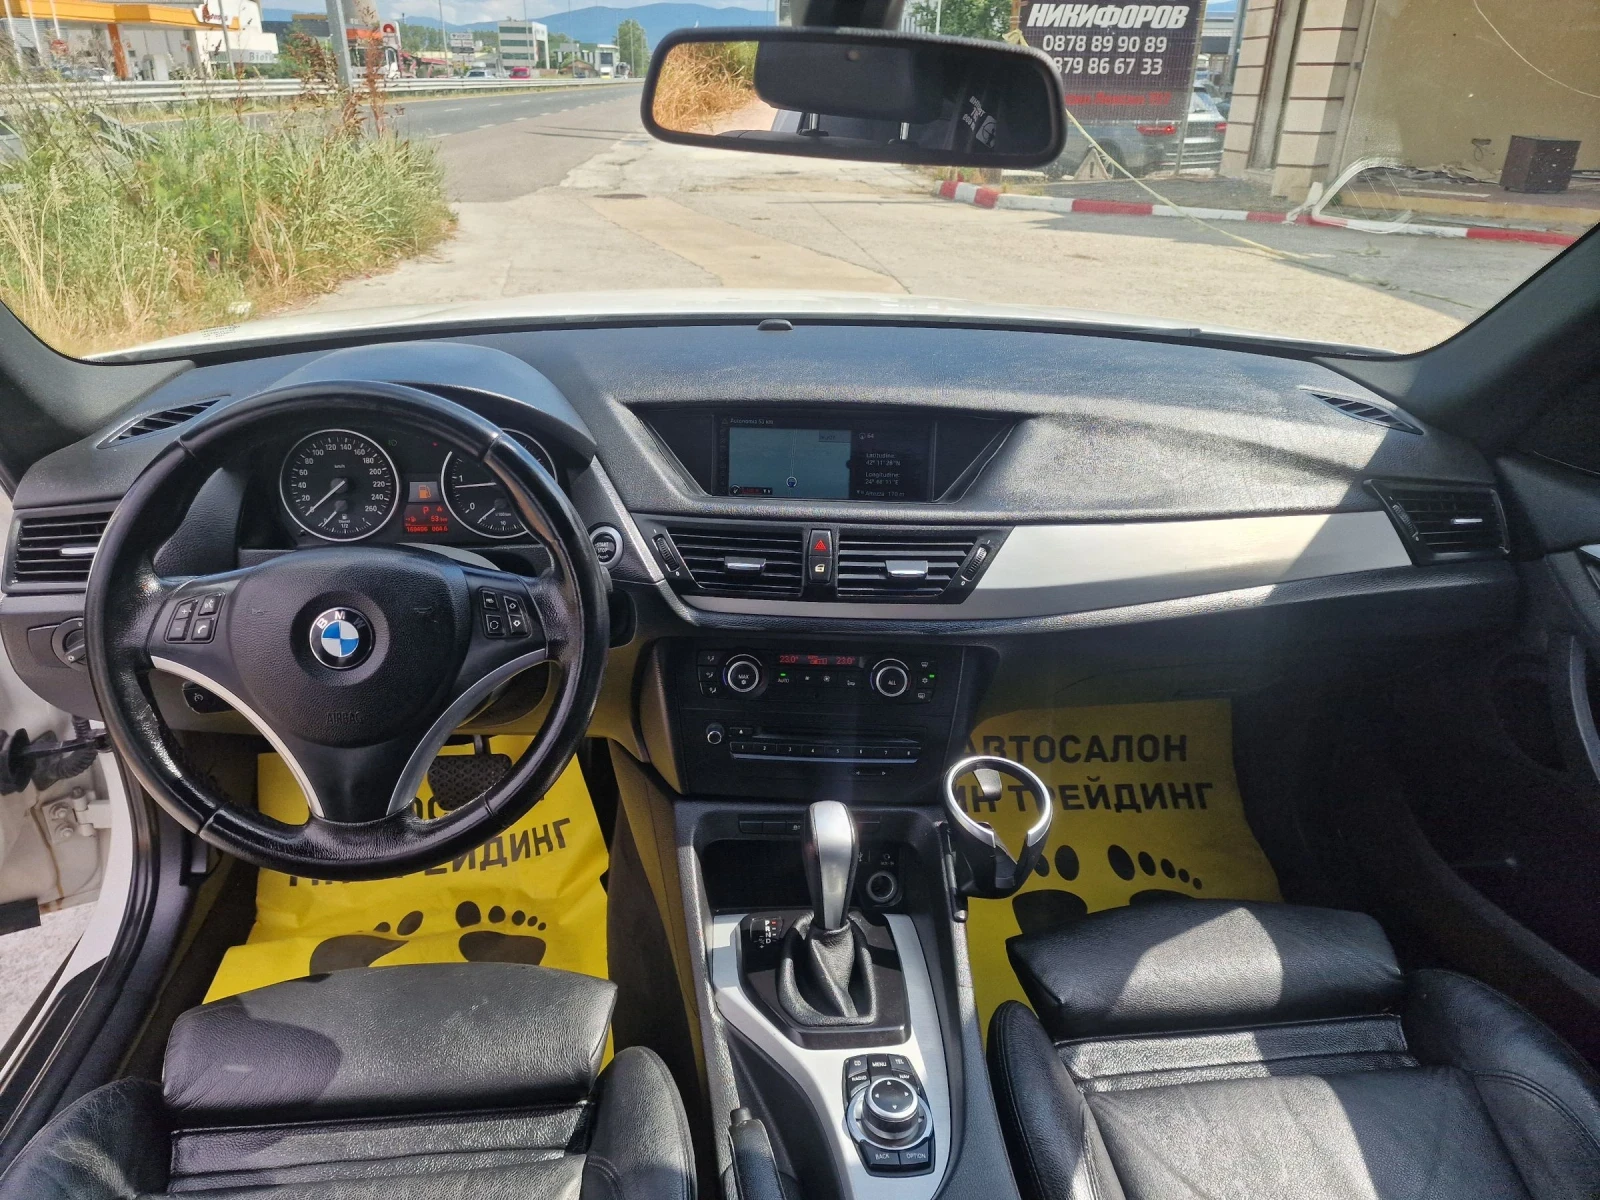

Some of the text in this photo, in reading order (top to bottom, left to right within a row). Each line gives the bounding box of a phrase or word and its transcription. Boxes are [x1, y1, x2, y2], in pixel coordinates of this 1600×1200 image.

[1026, 3, 1190, 29] НИКИФОРОВ
[1042, 34, 1168, 53] 0878 89 90 89
[1054, 57, 1163, 75] 879 86 67 33
[304, 457, 314, 465] 80
[299, 468, 308, 476] 60
[298, 481, 307, 489] 40
[372, 480, 385, 488] 220
[371, 493, 384, 501] 240
[469, 502, 476, 510] 0
[1007, 776, 1213, 813] ТЕЙДИНГ
